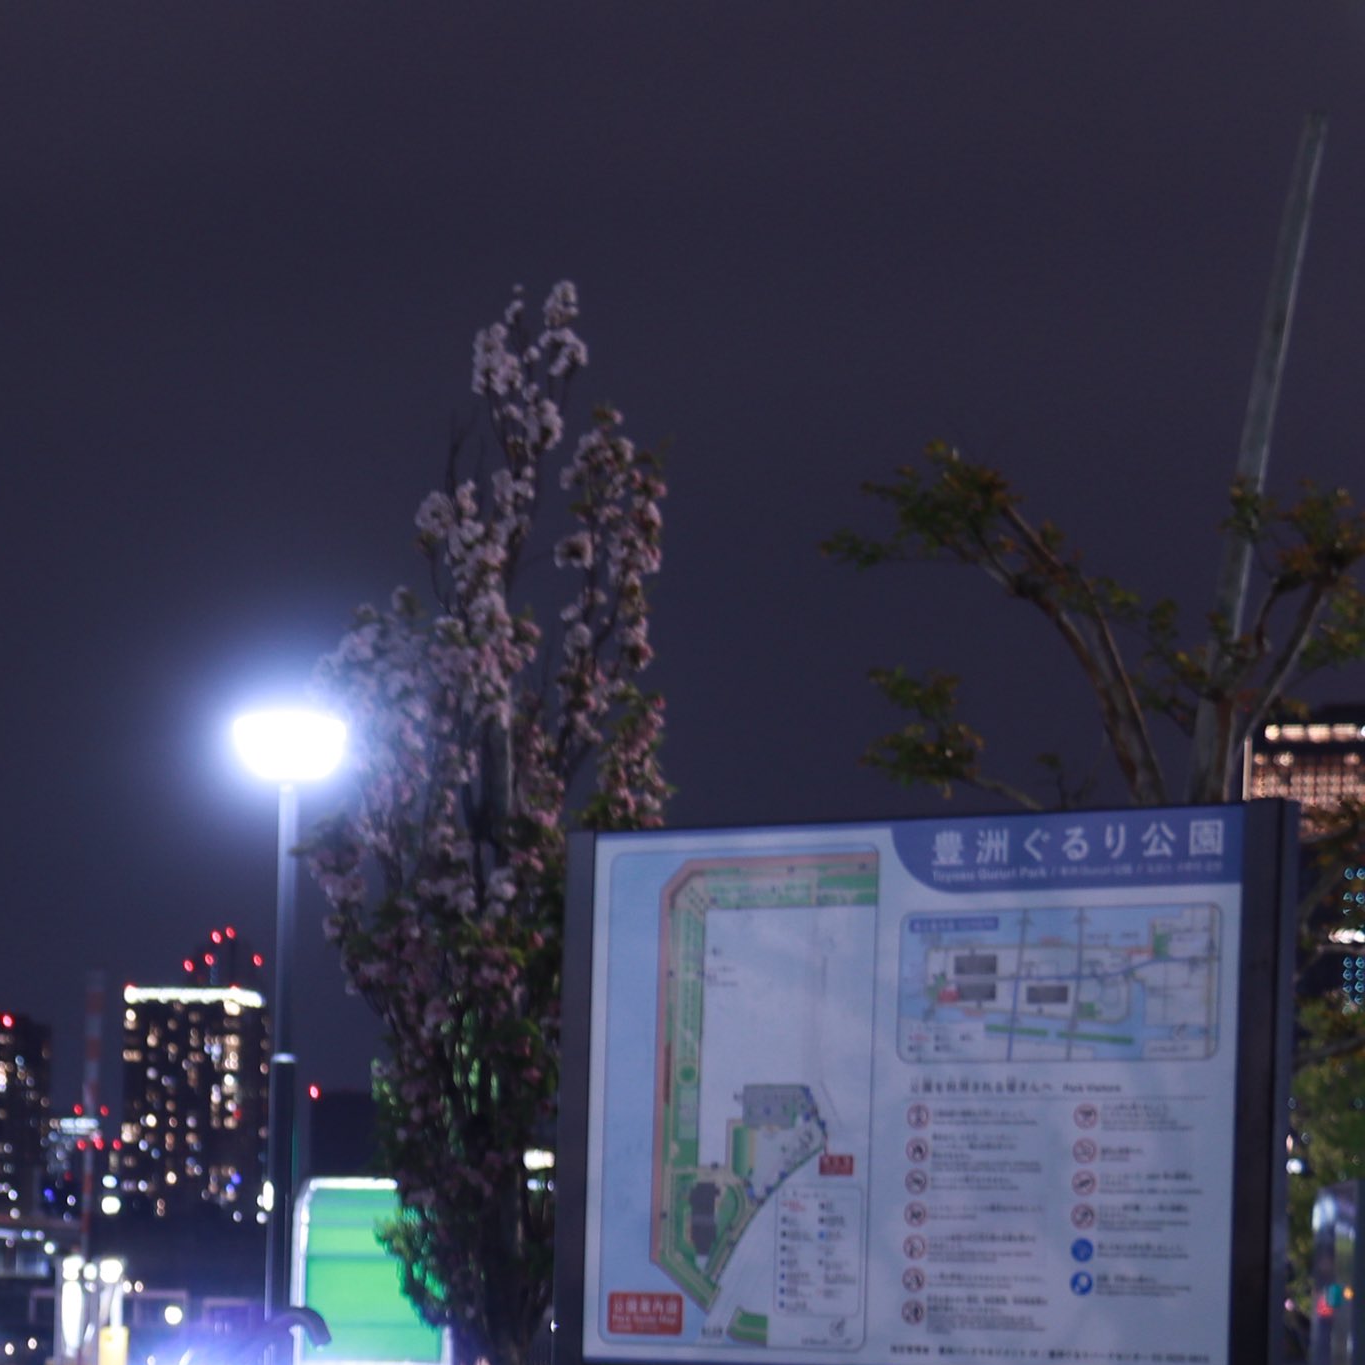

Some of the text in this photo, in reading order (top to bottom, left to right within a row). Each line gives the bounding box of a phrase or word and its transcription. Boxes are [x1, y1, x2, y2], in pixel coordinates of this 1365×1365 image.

[931, 820, 1224, 866] 豊洲ぐるり公園
[1020, 865, 1047, 880] Park
